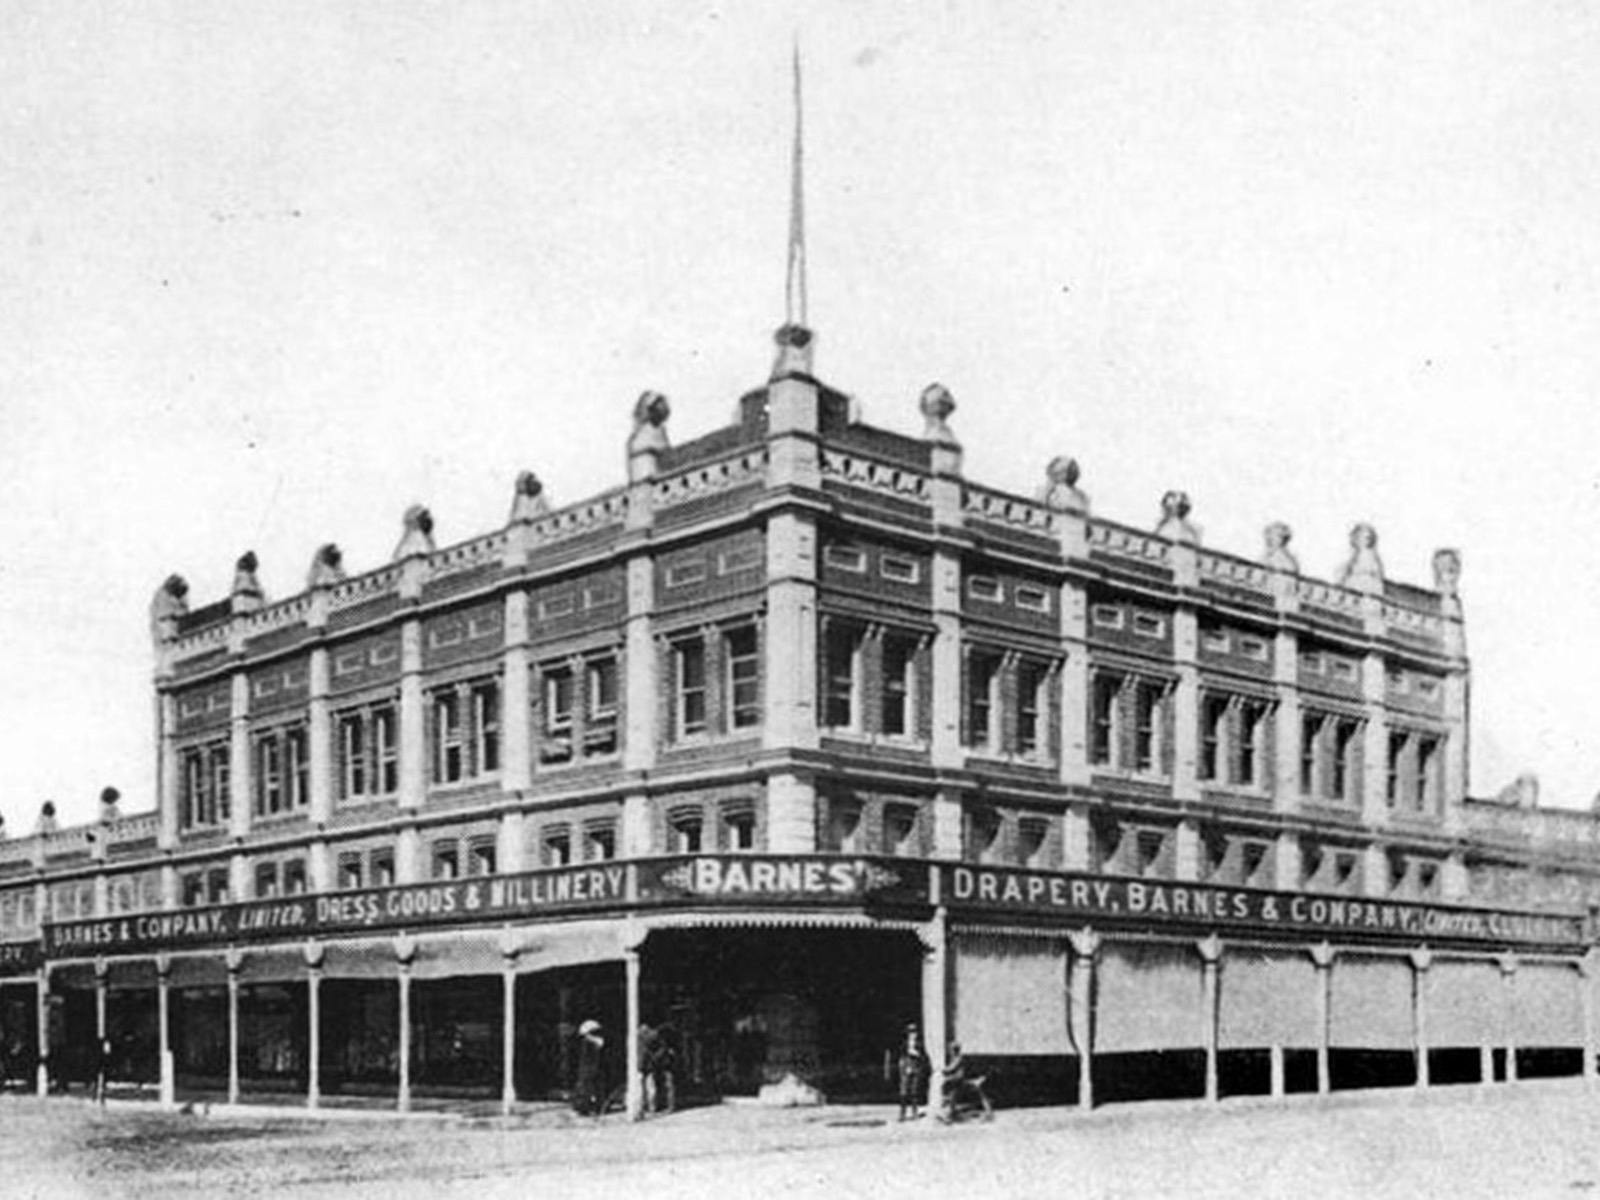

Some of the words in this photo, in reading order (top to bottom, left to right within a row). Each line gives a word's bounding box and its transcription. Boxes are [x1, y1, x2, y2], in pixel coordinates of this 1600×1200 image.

[387, 886, 456, 915] GOODS
[465, 884, 481, 910] &
[491, 867, 625, 907] MILLINERY
[695, 857, 865, 894] BARNES'
[953, 867, 1119, 913] DRAPERY,
[1126, 881, 1249, 919] BARNES
[1261, 895, 1280, 921] &
[1290, 896, 1418, 928] COMPANY,
